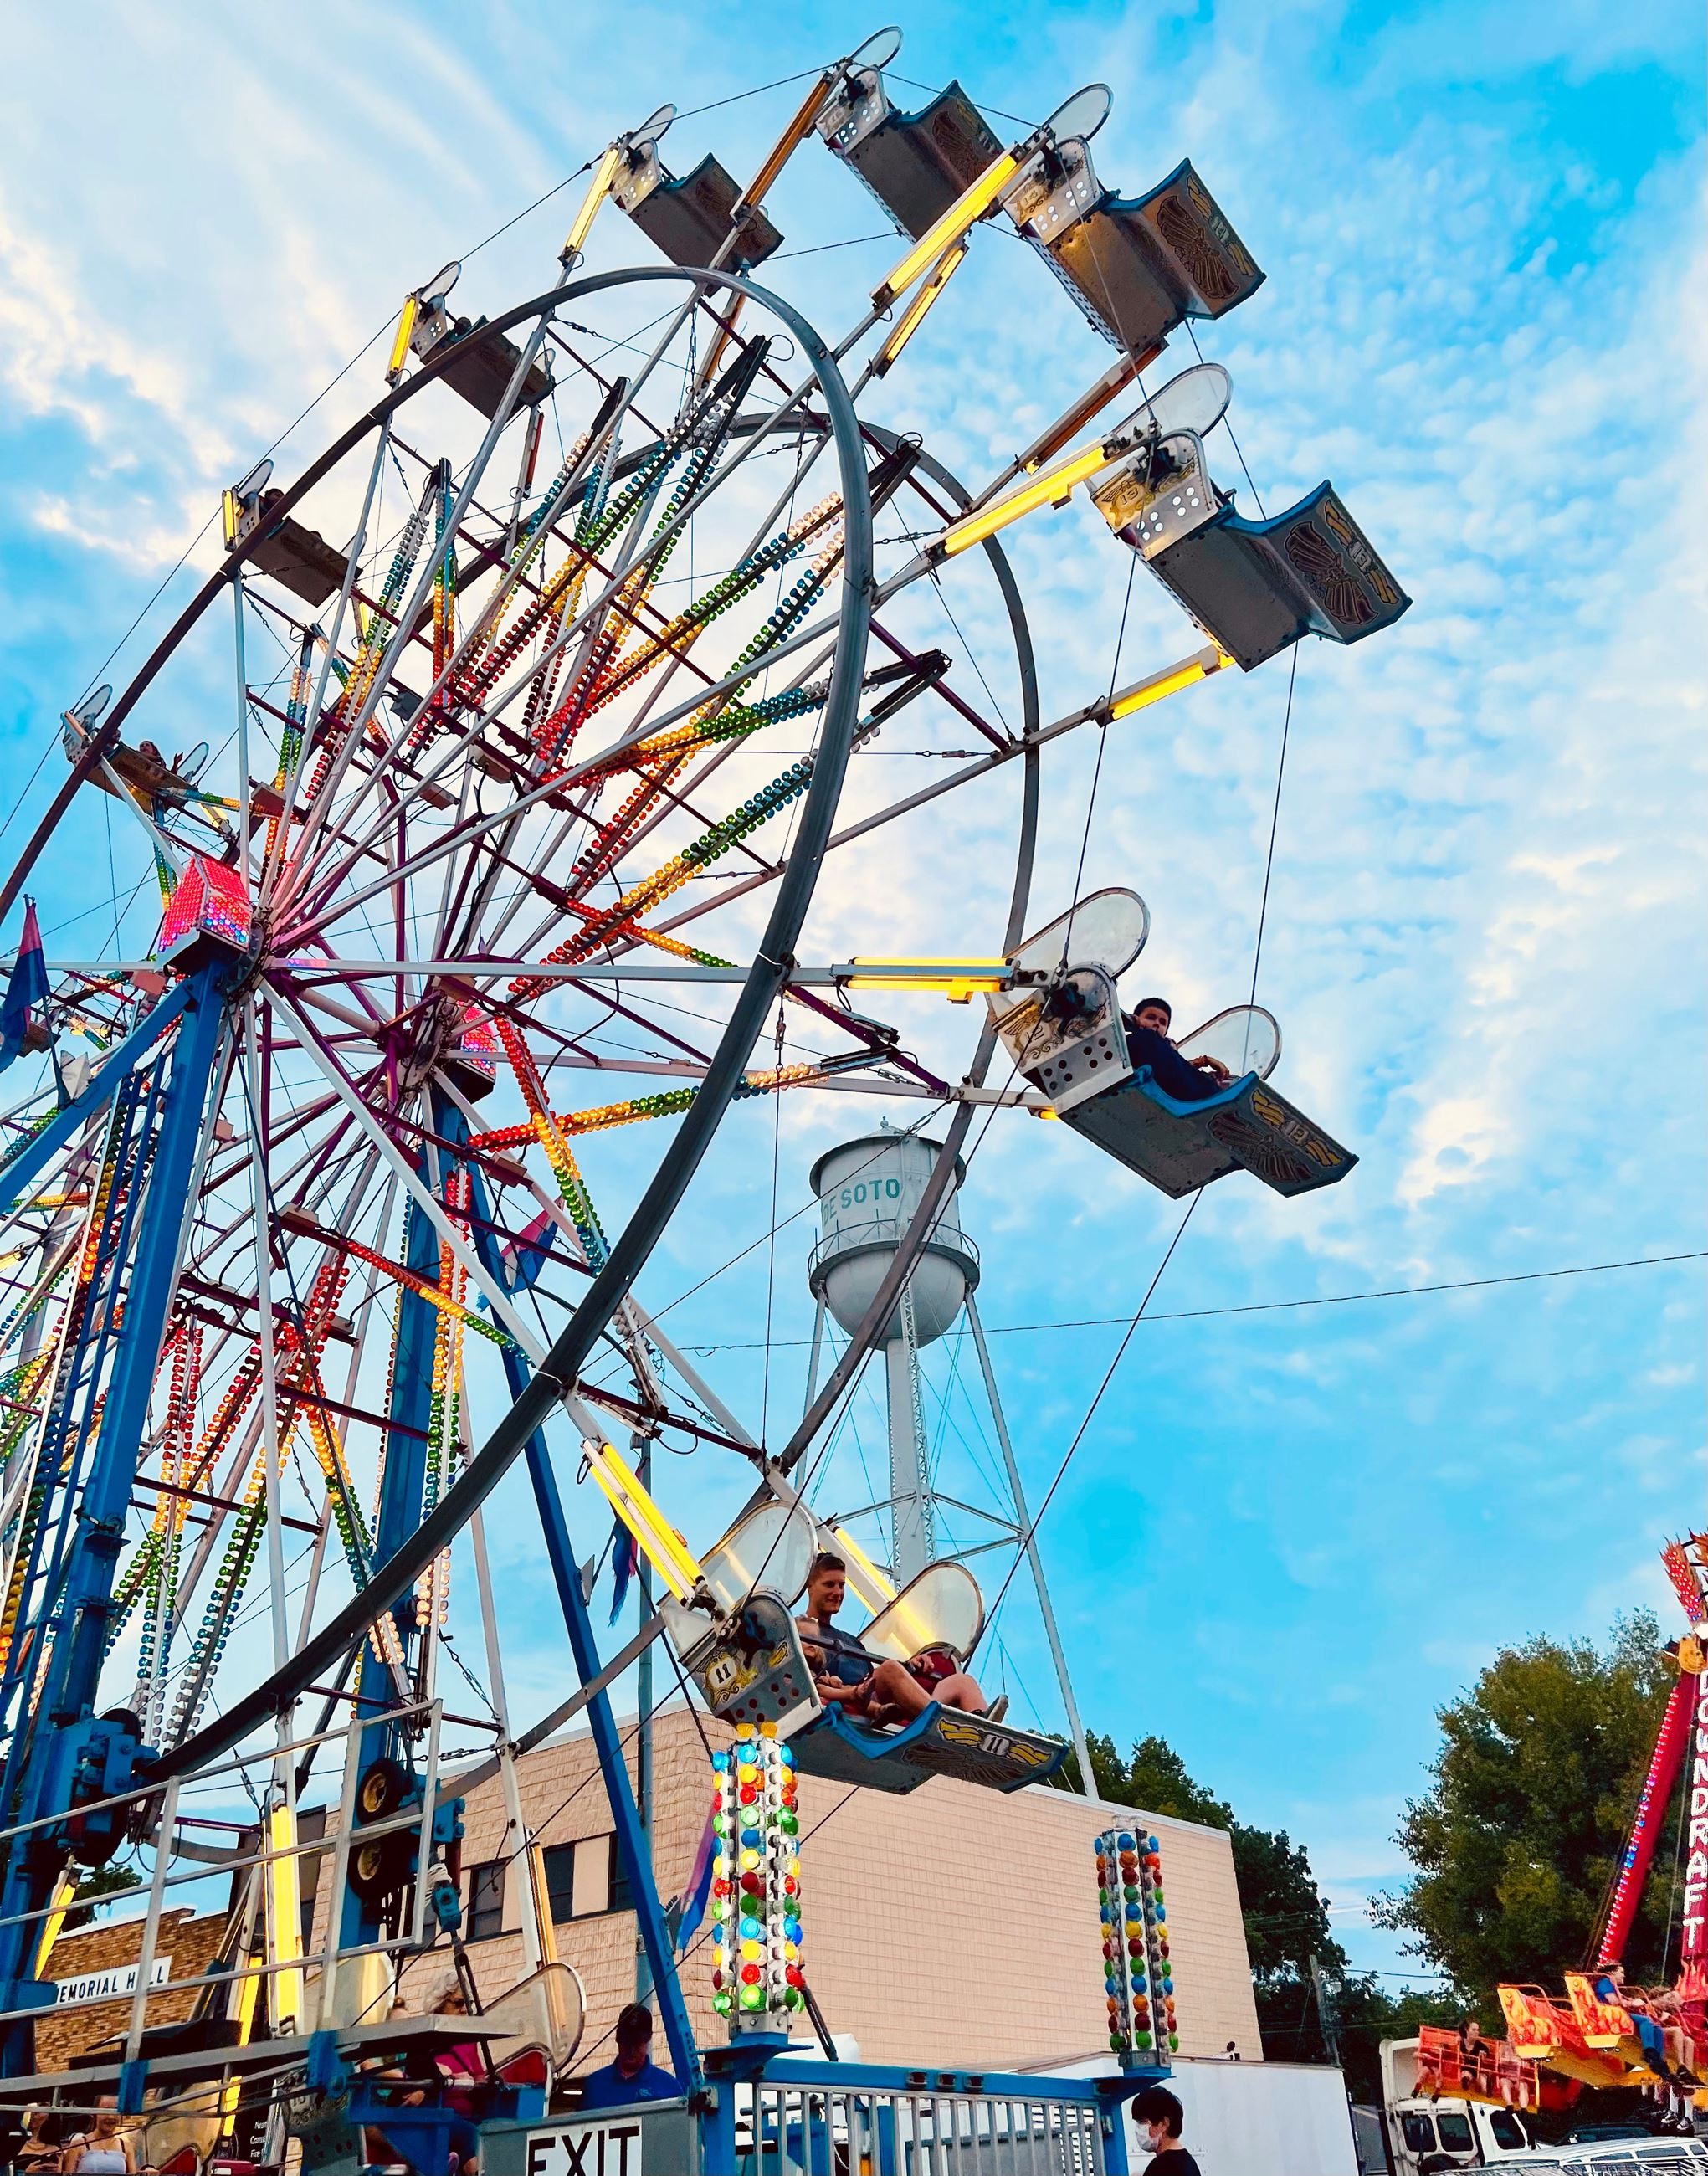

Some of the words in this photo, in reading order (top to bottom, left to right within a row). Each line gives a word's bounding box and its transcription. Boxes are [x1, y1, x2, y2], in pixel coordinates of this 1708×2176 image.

[840, 1178, 900, 1210] SOTO
[716, 1663, 731, 1684] 11
[986, 1736, 1003, 1753] 11
[57, 1975, 118, 2004] EMORIAL
[126, 1965, 164, 1990] HL
[527, 2125, 640, 2176] EXIT
